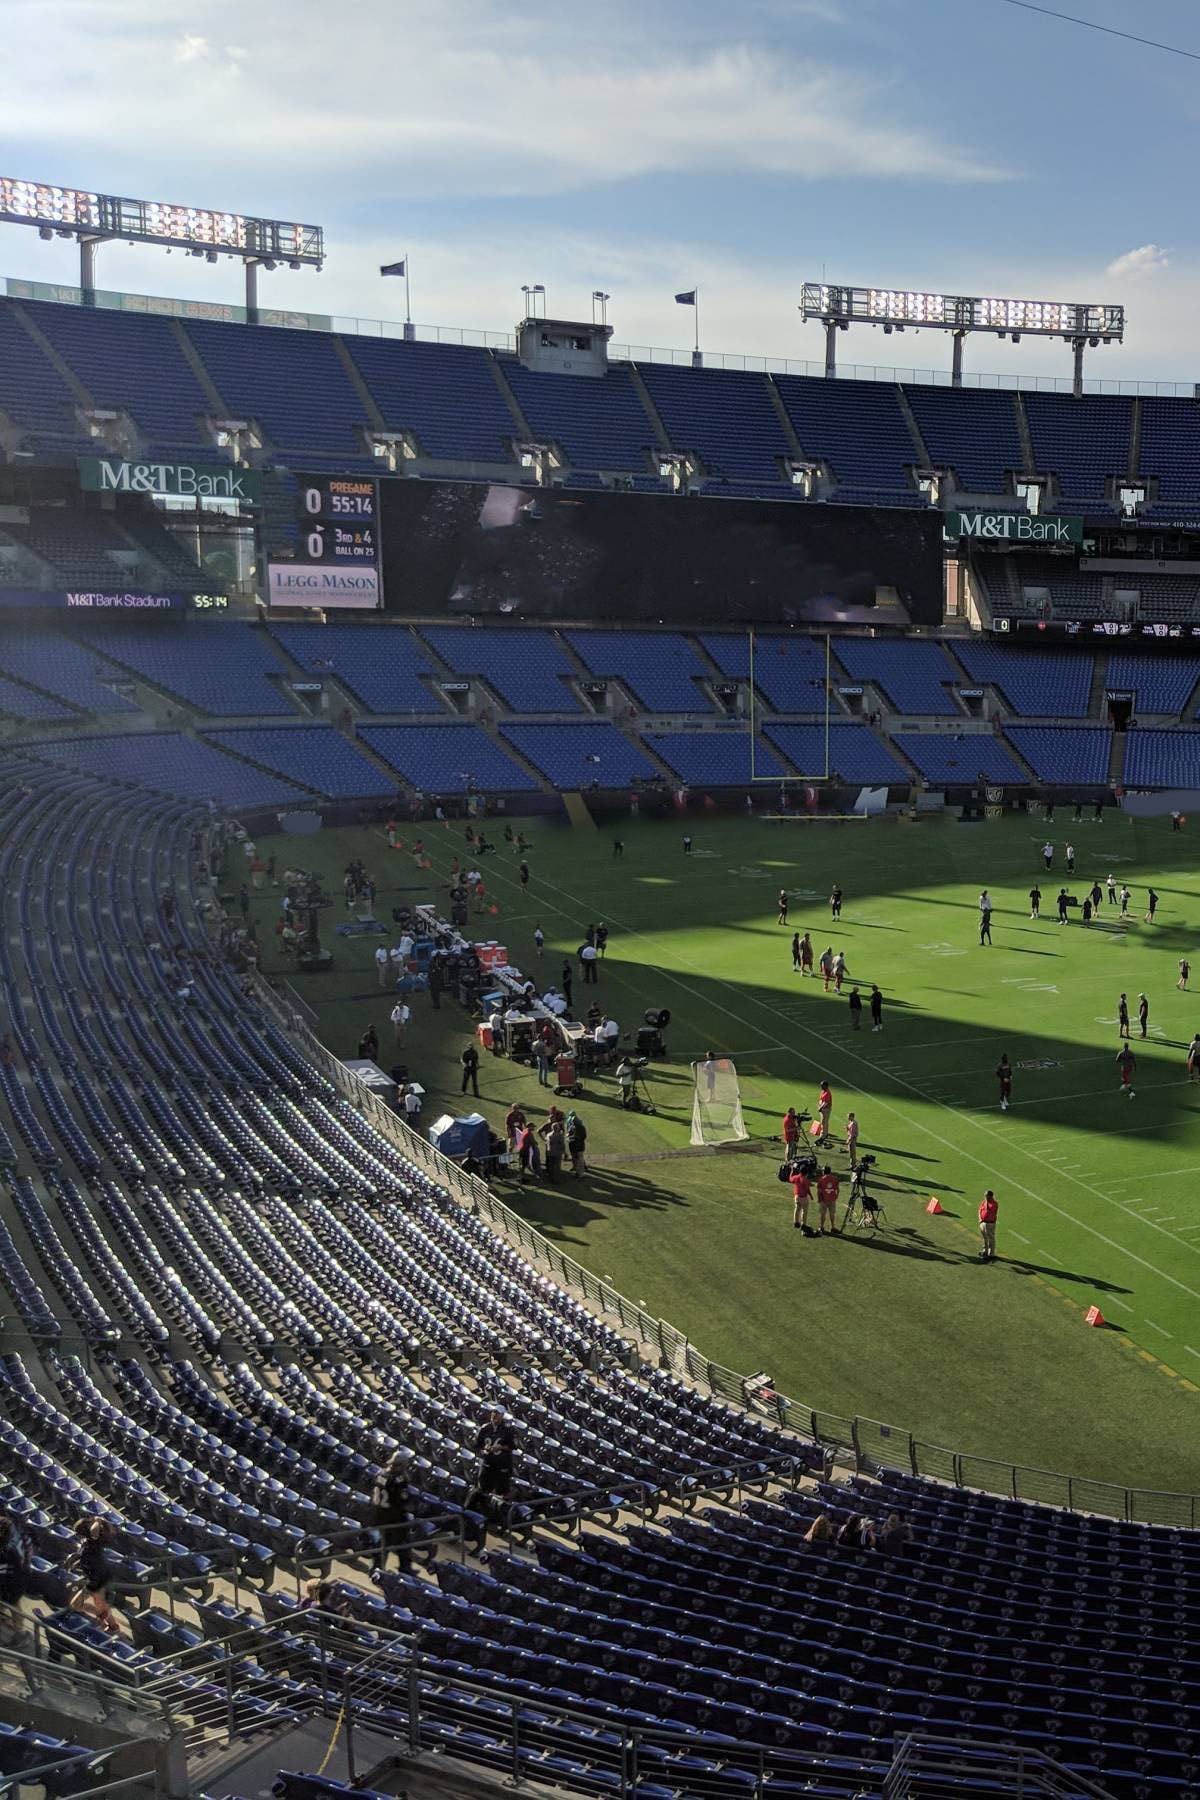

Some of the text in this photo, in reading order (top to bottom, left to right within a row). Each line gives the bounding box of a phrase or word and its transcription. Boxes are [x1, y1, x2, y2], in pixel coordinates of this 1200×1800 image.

[99, 460, 245, 497] M&T Bank
[330, 481, 373, 495] PREGAME
[306, 488, 322, 514] 0
[332, 496, 373, 514] 55:14
[959, 513, 1070, 540] M&T Bank
[308, 533, 323, 558] 0
[354, 533, 362, 544] &
[363, 530, 372, 544] 4
[335, 546, 375, 556] BALL ON 25
[276, 573, 376, 589] LEGG MASON
[67, 593, 171, 607] M&T Bank Stadium
